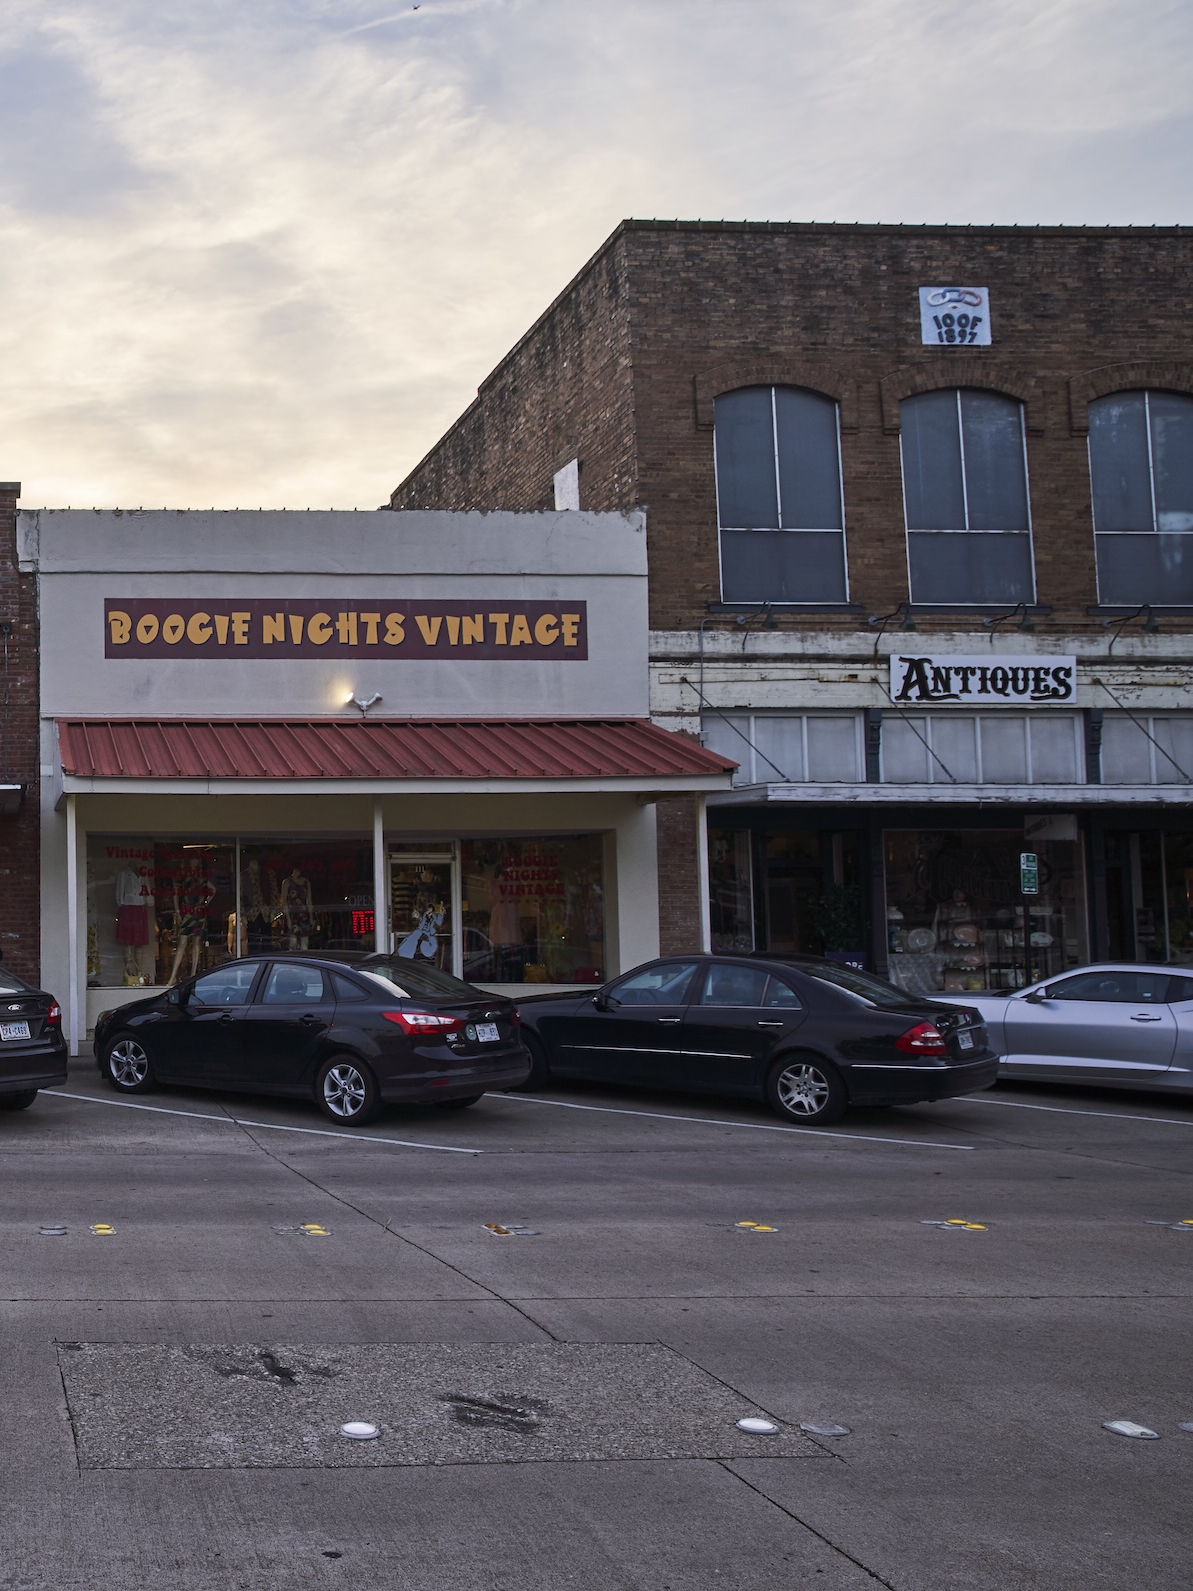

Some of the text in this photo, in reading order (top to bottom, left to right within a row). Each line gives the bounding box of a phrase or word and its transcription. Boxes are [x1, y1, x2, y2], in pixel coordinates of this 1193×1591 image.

[937, 328, 978, 343] 1897
[108, 610, 581, 647] BOOGIE NIGHTS VINTAGE
[894, 656, 1073, 701] ANTIQUES
[106, 847, 155, 860] Vintage
[504, 869, 560, 882] NIGHTS
[499, 882, 566, 896] VINTAGE
